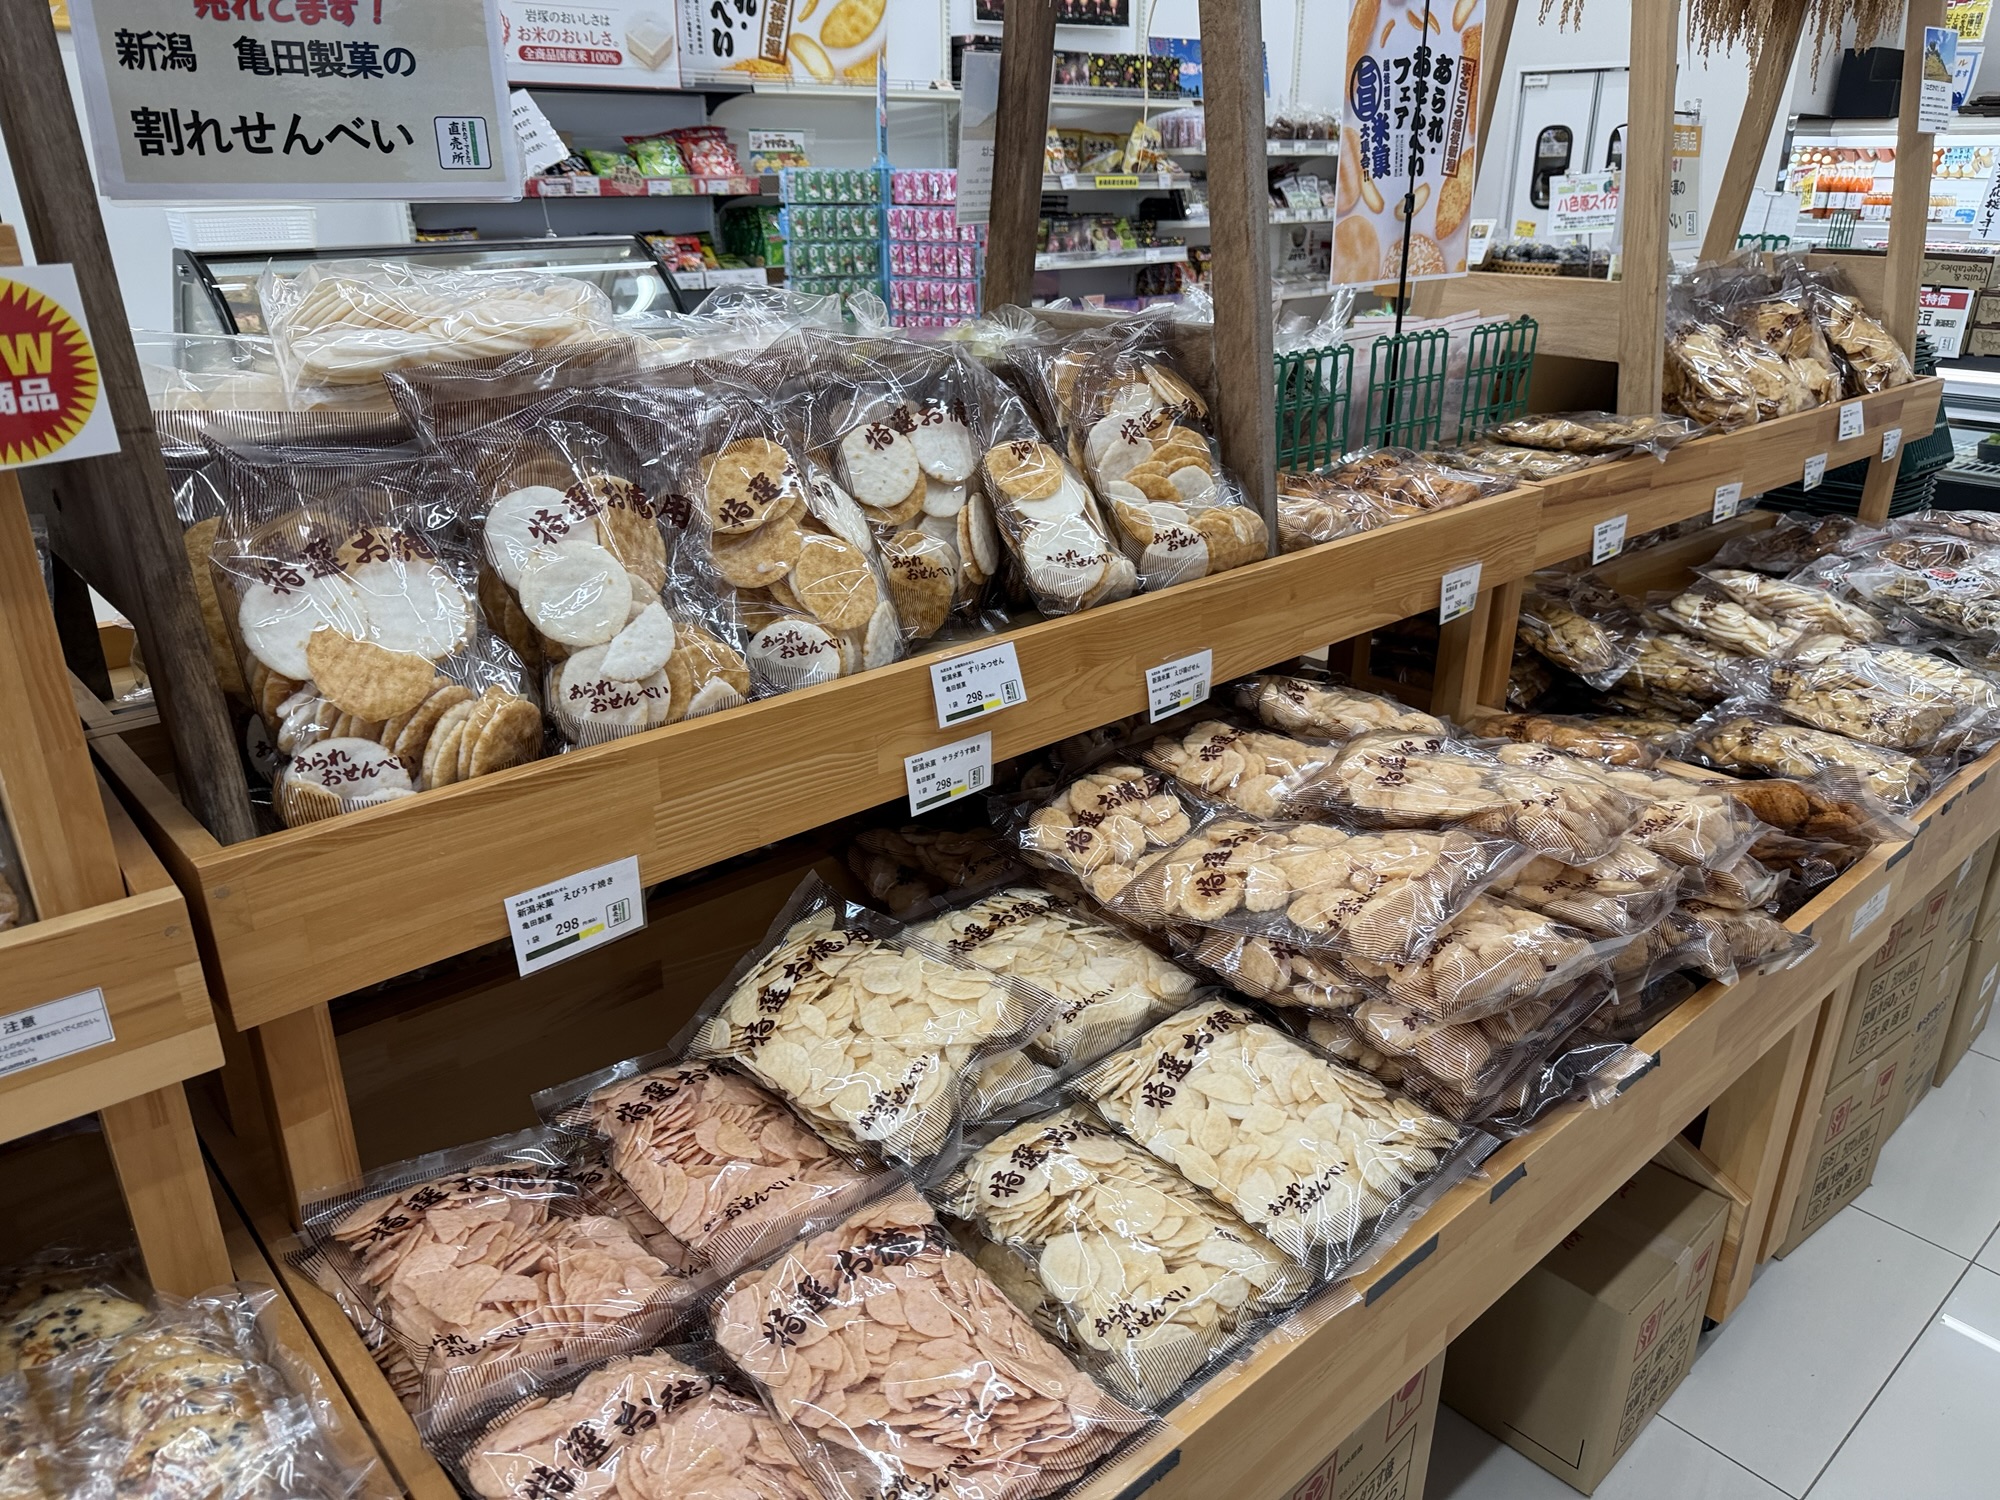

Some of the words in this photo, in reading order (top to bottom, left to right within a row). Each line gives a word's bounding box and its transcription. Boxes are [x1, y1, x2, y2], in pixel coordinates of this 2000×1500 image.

[525, 8, 611, 27] 岩塚のおいしさは
[765, 0, 789, 57] 後新潟
[114, 27, 197, 73] 新潟
[232, 35, 417, 80] 亀田製菓の
[523, 47, 588, 63] 全商品国産米
[590, 51, 619, 65] 100%
[1392, 56, 1412, 130] フェア
[1356, 60, 1378, 119] 旨
[1371, 111, 1392, 180] 米菓
[1408, 45, 1432, 177] おせんべい
[1444, 61, 1473, 174] 米どころ越後新潟
[130, 106, 416, 157] 割れせんべい
[448, 121, 466, 166] 直売所
[1940, 263, 1989, 277] Vegetables
[1954, 273, 1961, 281] &
[1962, 273, 1987, 284] Fruits
[1917, 310, 1935, 327] 豆
[1153, 527, 1184, 545] あられ
[1167, 529, 1213, 552] おせんべい
[892, 554, 924, 570] あられ
[906, 564, 957, 581] おせんべい
[761, 629, 803, 649] あられ
[780, 636, 848, 660] おせんべい
[941, 670, 963, 683] 新潟米菓
[967, 657, 1005, 675] すりみつせん
[568, 679, 617, 701] あられ
[589, 684, 670, 714] おせんべい
[945, 681, 967, 693] 亀田製菓
[965, 690, 984, 705] 298
[294, 748, 351, 773] あられ
[322, 754, 416, 787] おせんべい
[912, 758, 937, 773] 新潟米菓
[941, 744, 981, 763] サラダうす焼き
[915, 772, 936, 785] 亀田製菓
[935, 777, 952, 792] 298
[517, 898, 555, 919] 新潟米菓
[563, 876, 614, 902] えびうす焼き
[521, 912, 553, 931] 亀田製菓
[555, 917, 580, 937] 298
[745, 927, 876, 1048] 特選お徳用
[3, 1015, 37, 1035] 注意
[724, 1176, 797, 1222] おせんべい
[1266, 1181, 1305, 1217] あられ
[1294, 1160, 1350, 1215] おせんべい
[1095, 1301, 1138, 1338] あられ
[1122, 1285, 1192, 1338] おせんべい
[429, 1333, 469, 1351] られ
